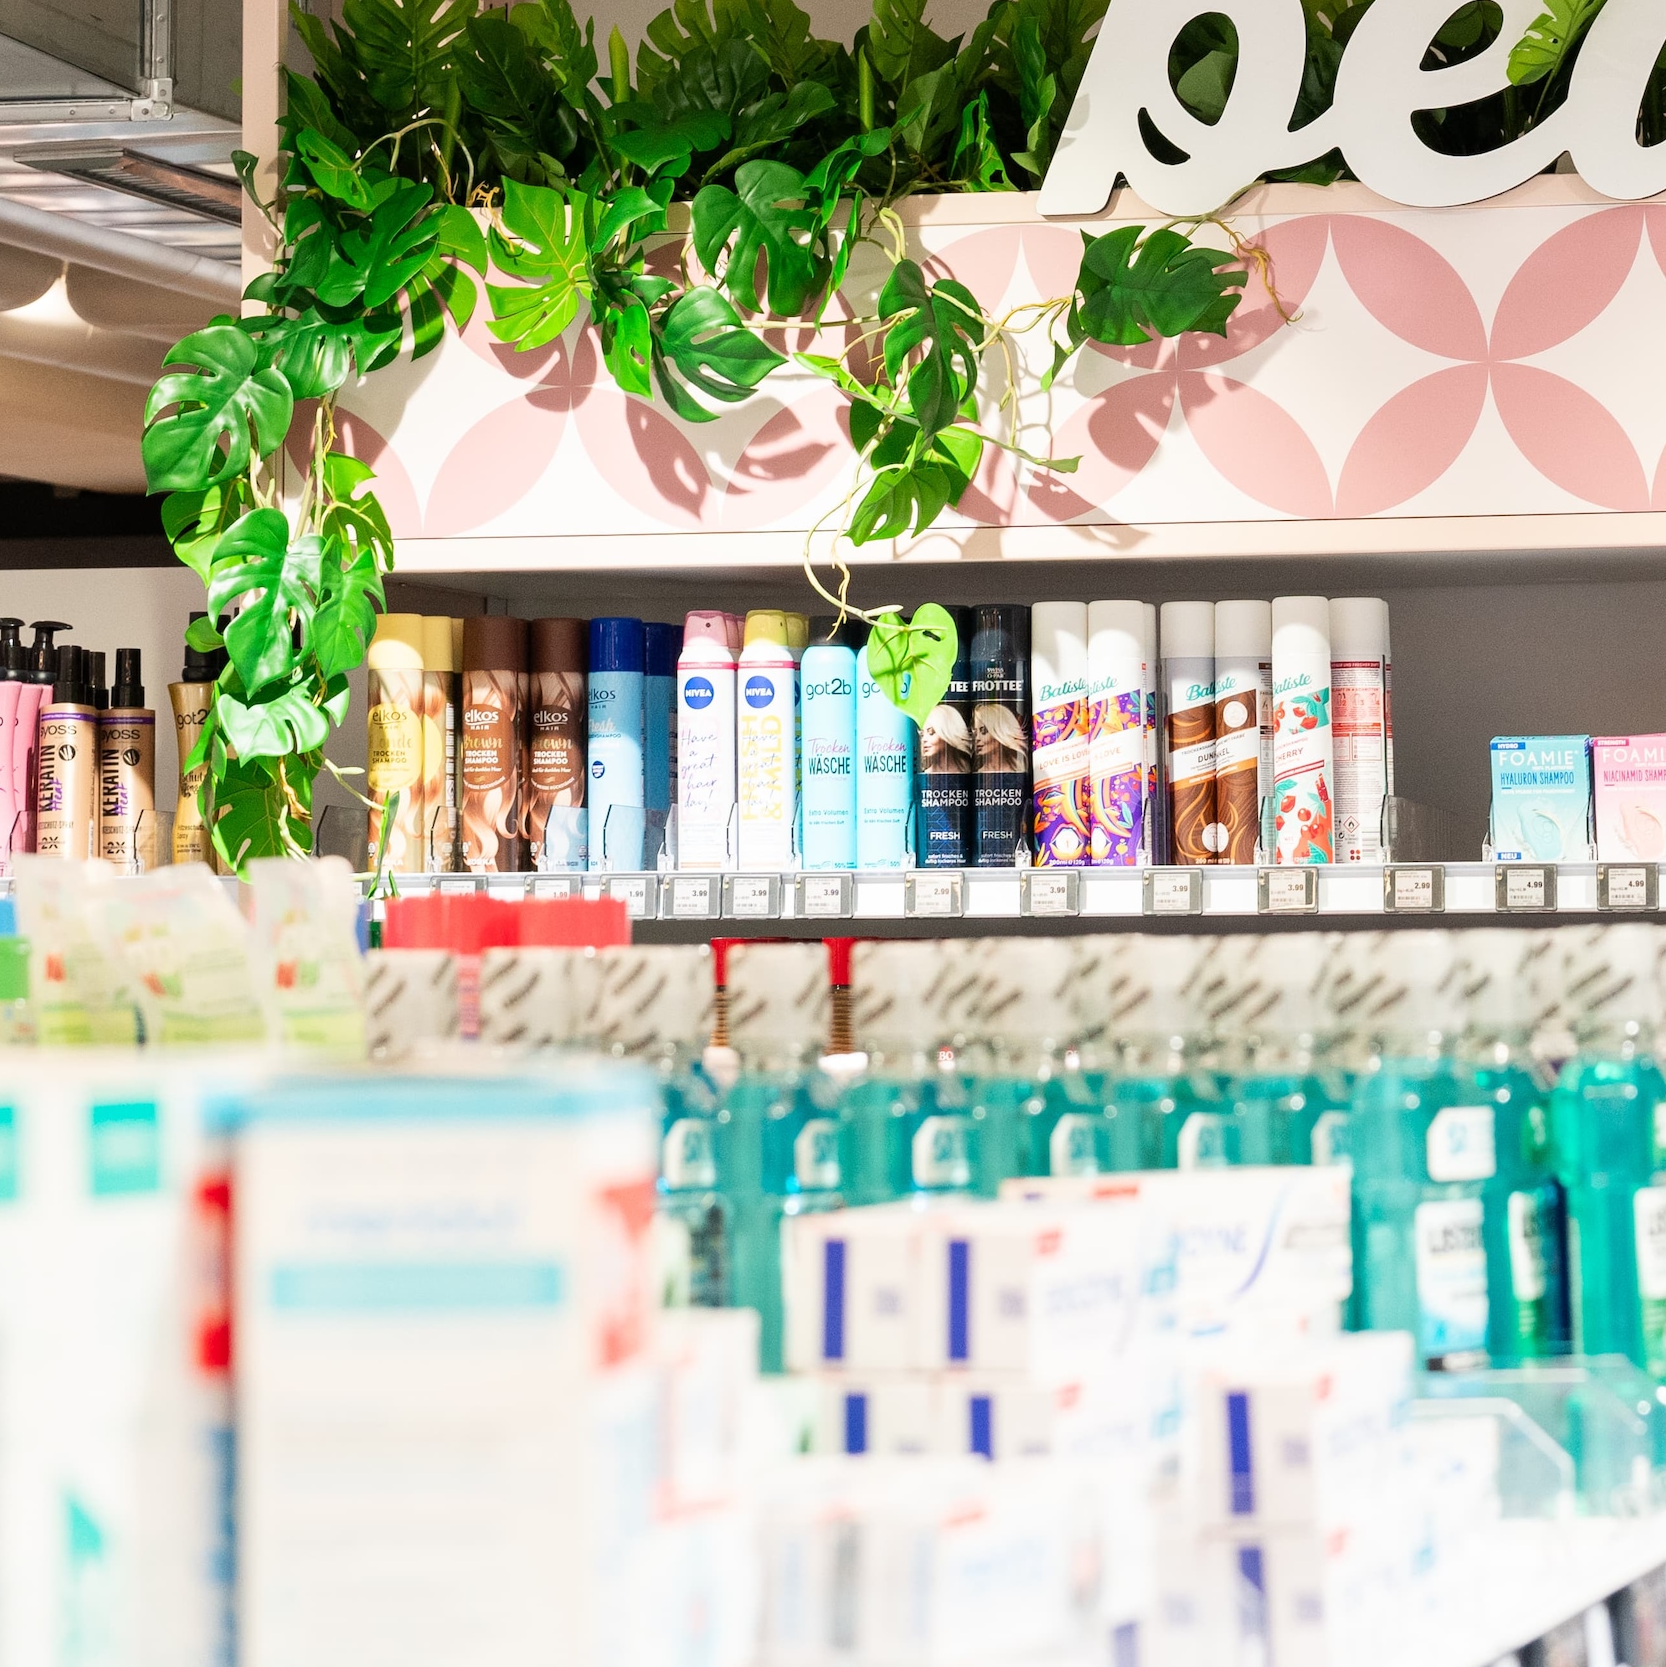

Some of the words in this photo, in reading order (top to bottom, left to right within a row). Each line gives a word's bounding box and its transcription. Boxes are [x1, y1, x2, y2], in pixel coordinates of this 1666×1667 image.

[746, 688, 773, 696] NIVEA
[806, 678, 851, 700] got2b
[973, 680, 1022, 692] FROTTEE
[685, 689, 713, 697] NIVEA
[373, 711, 407, 722] elkos
[465, 710, 499, 723] elkos
[533, 711, 568, 723] elkos
[681, 728, 717, 743] Have
[808, 738, 851, 753] Trocken
[864, 736, 906, 752] Trocken
[864, 752, 906, 773] WÄSCHE
[1039, 757, 1060, 770] LOVE
[1500, 750, 1574, 765] FOAMIE
[809, 753, 850, 775] WÄSCHE
[40, 745, 55, 812] KERATIN
[1501, 772, 1537, 785] HYALURON
[1539, 771, 1575, 784] SHAMPOO
[1603, 770, 1643, 782] NIACINAMID
[103, 749, 119, 816] KERATIN
[922, 790, 968, 798] TROCKEN
[975, 789, 1021, 797] TROCKEN
[922, 798, 969, 807] SHAMPOO
[975, 798, 1021, 806] SHAMPOO
[930, 831, 960, 840] FRESH
[983, 831, 1012, 839] FRESH
[1501, 852, 1517, 860] NEU
[1414, 881, 1431, 889] 2.99
[1527, 881, 1543, 889] 4.99
[1629, 880, 1645, 888] 4.99
